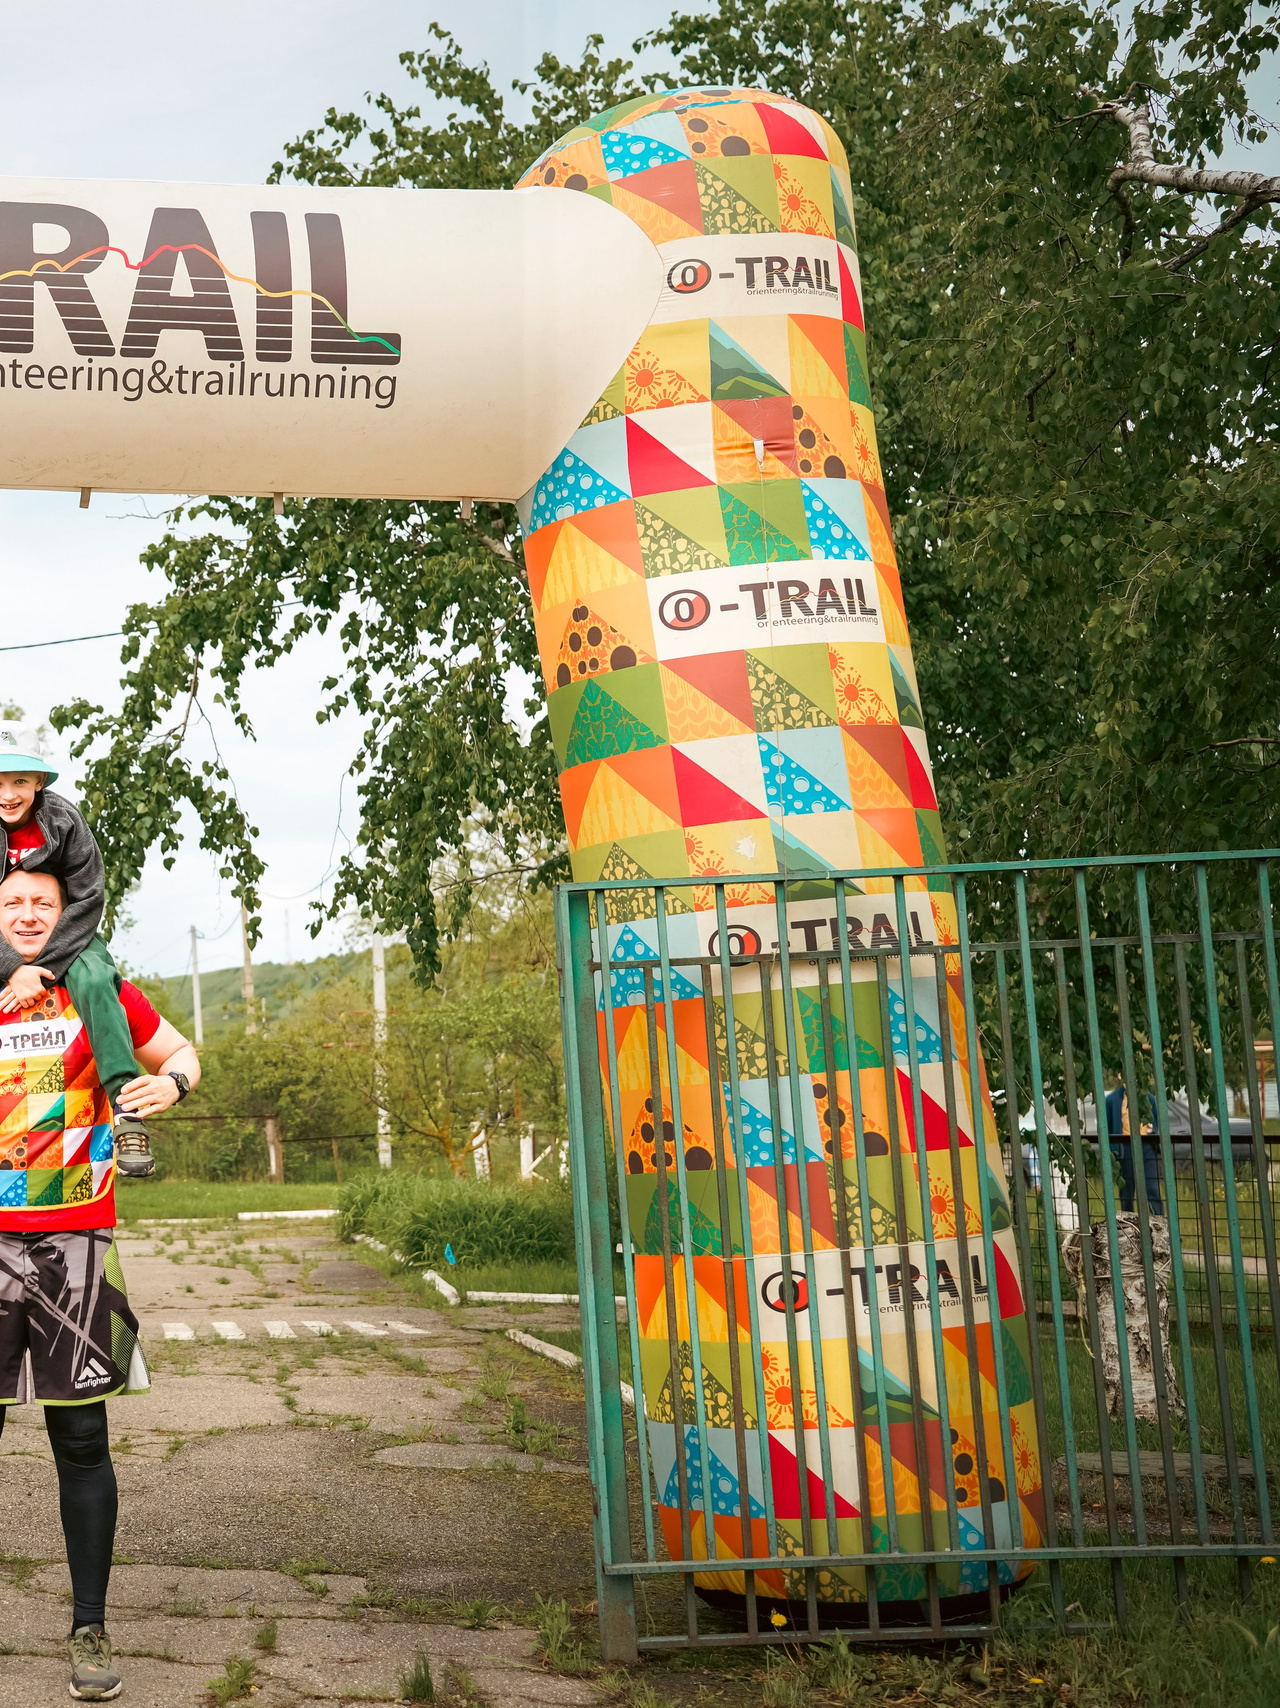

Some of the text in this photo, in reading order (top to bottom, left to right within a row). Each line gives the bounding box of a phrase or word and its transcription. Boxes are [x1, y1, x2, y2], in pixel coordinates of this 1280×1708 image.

[746, 286, 839, 301] orienteering&trailrunning
[757, 615, 879, 629] orenteering&trailrunning
[74, 1376, 112, 1390] iamfighter
